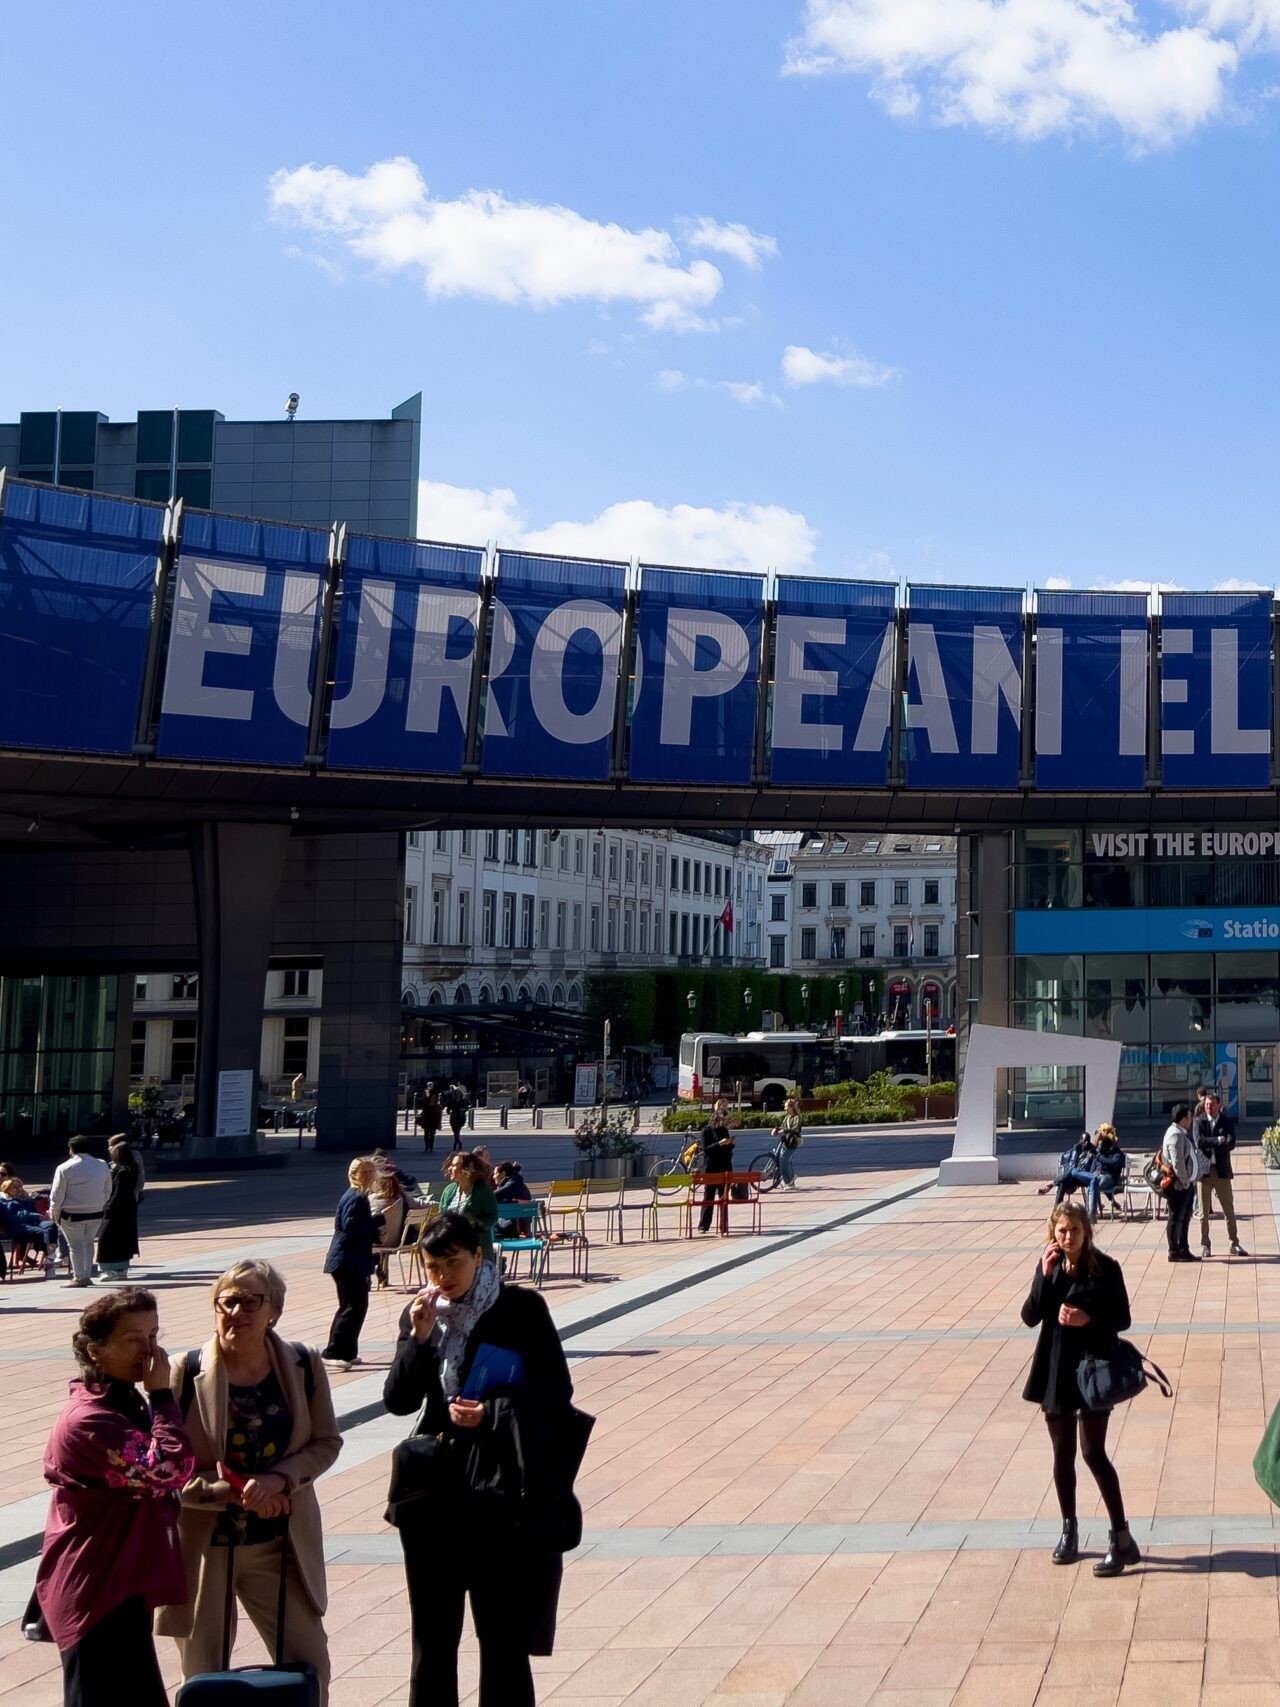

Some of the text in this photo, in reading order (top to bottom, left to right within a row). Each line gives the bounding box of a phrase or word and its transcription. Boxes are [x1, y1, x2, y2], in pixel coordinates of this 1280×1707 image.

[160, 554, 1063, 755] EUROPEAN
[1092, 833, 1148, 857] VISIT
[1153, 832, 1195, 856] THE
